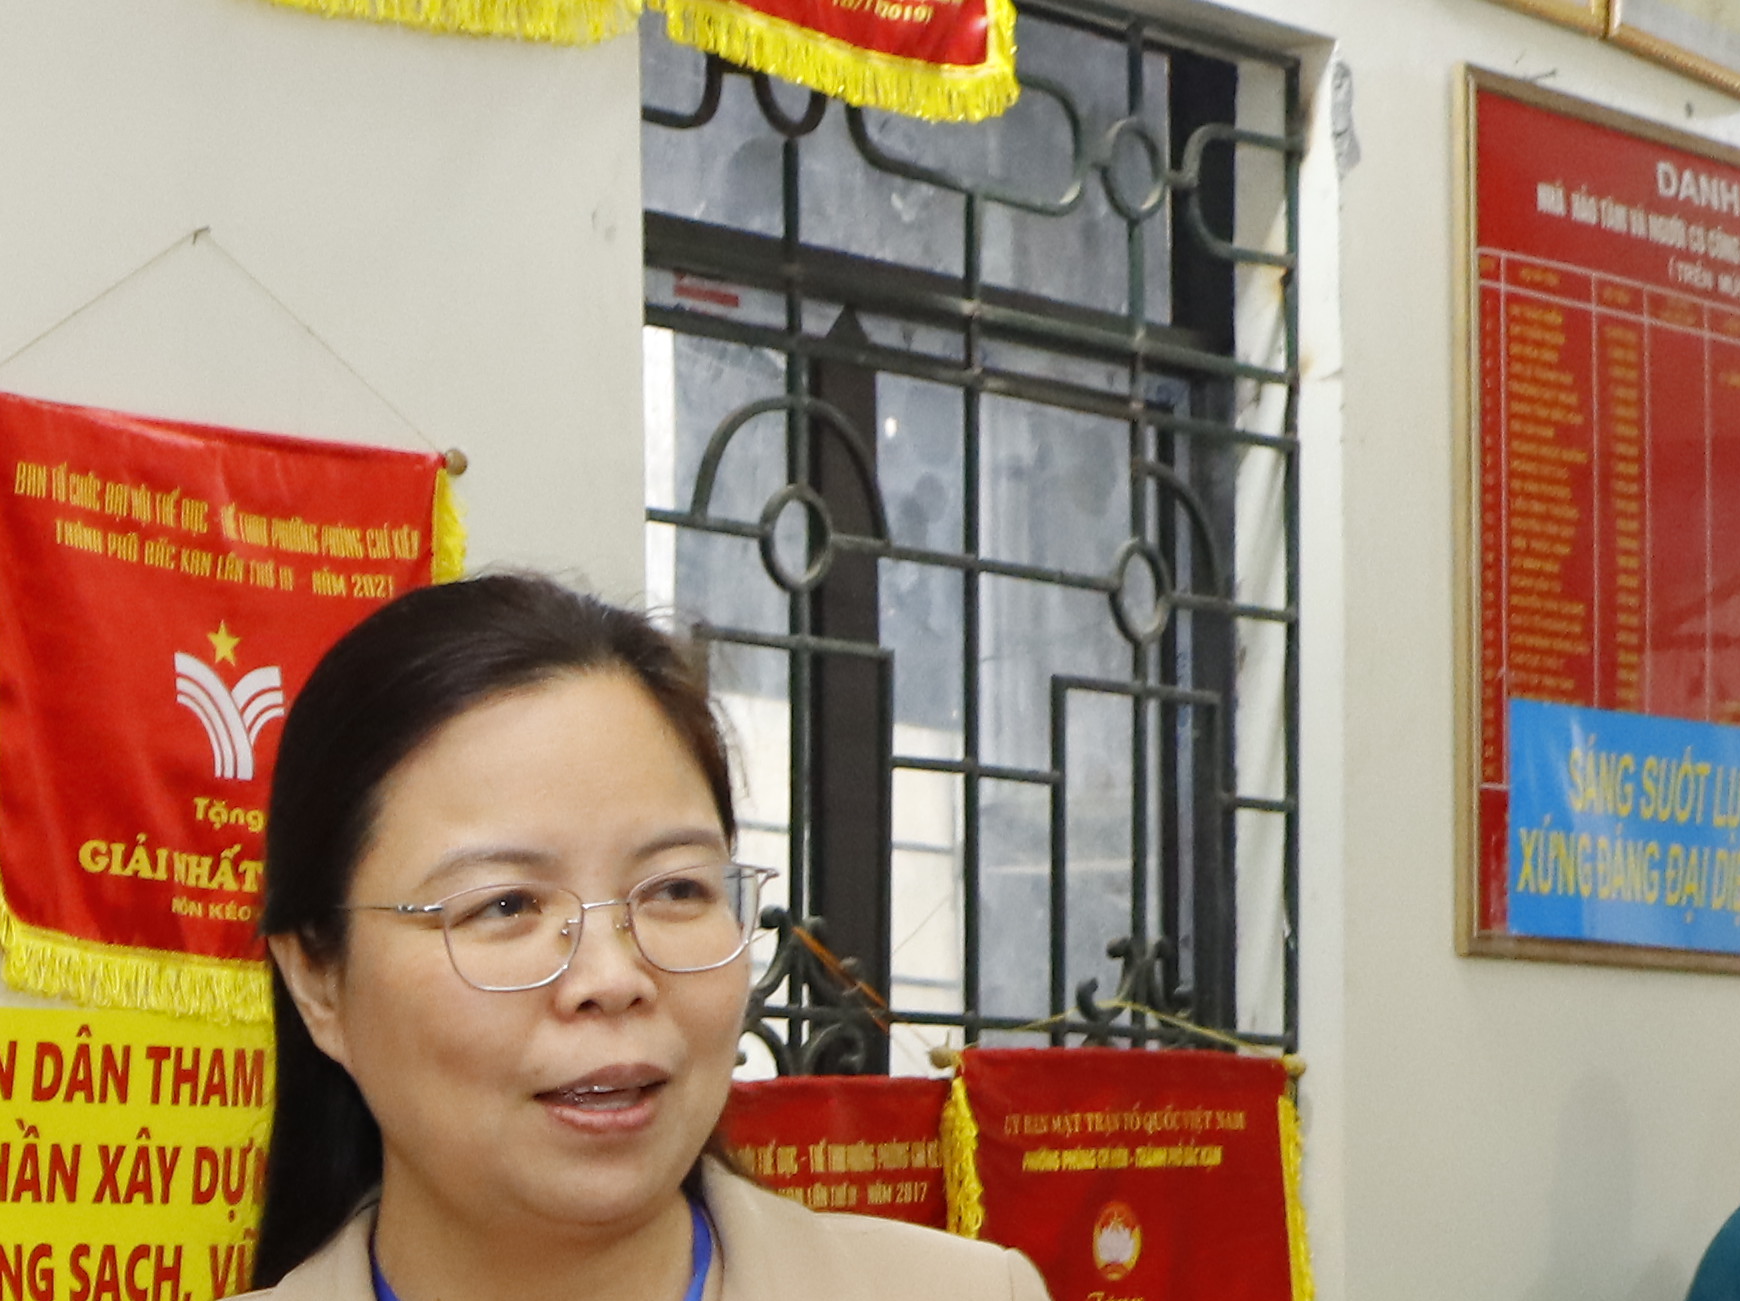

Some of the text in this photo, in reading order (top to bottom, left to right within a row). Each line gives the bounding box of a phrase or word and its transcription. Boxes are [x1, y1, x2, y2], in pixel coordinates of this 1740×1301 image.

[14, 461, 47, 498] BAN
[108, 531, 138, 563] PHỐ
[312, 567, 347, 597] NĂM
[351, 573, 394, 598] 2021
[1569, 733, 1635, 818] SÁNG
[1640, 745, 1710, 823] SUỐT
[193, 796, 265, 833] Tặng
[78, 832, 264, 893] GIẢI NHẤT
[1517, 814, 1592, 898] XỨNG
[1597, 823, 1660, 905] ĐÁNG
[1665, 844, 1710, 923] ĐẠI
[209, 900, 251, 922] KÉO
[32, 1024, 132, 1105] DÂN
[146, 1044, 267, 1109] THAM
[1215, 1110, 1246, 1131] NAM
[93, 1126, 182, 1204] XÂY
[896, 1181, 928, 1204] 2017
